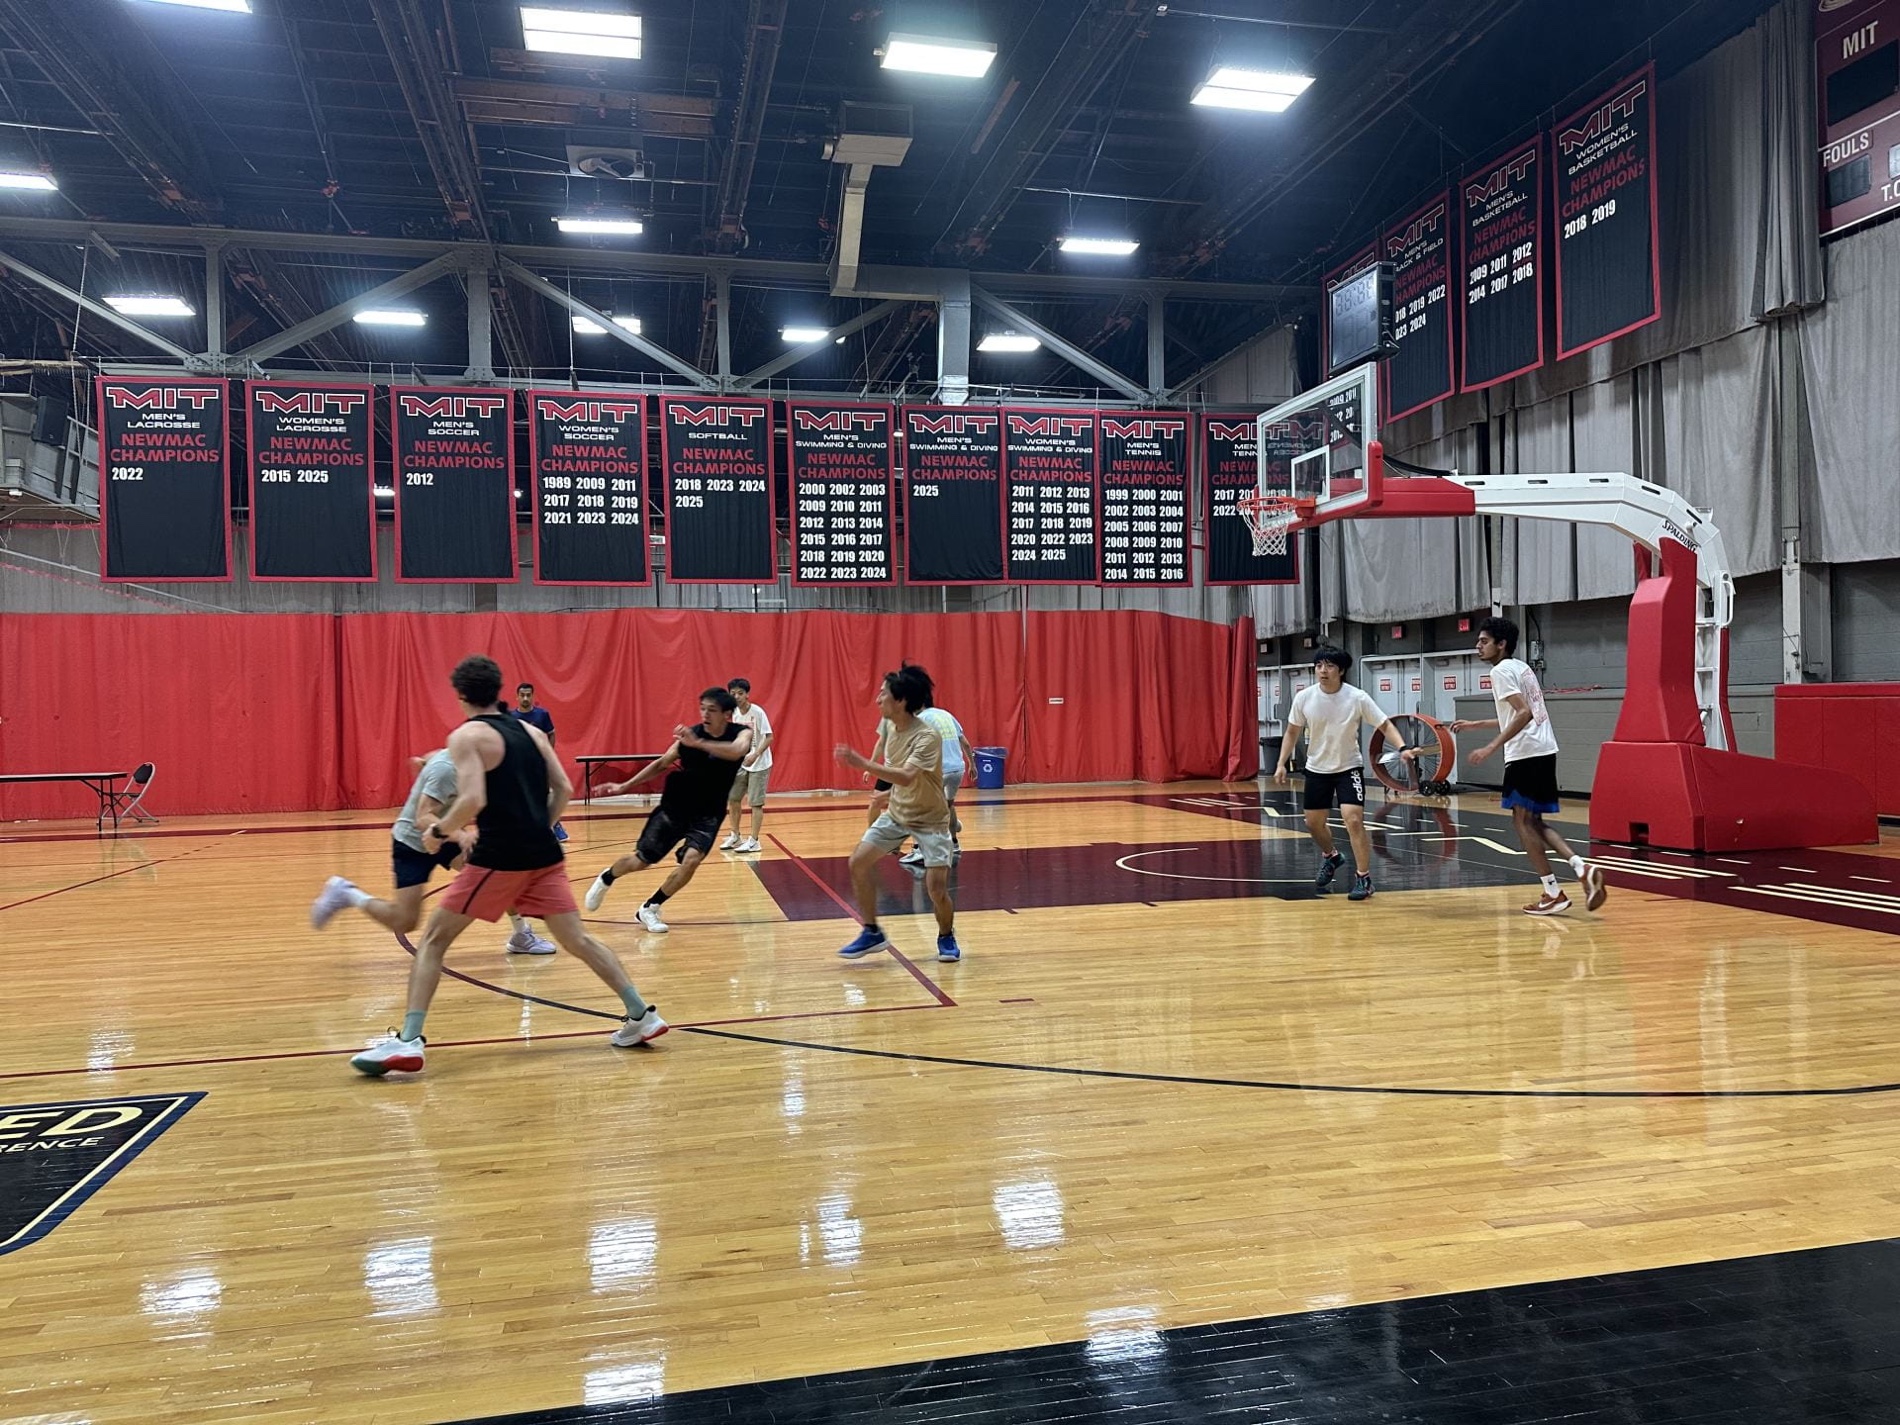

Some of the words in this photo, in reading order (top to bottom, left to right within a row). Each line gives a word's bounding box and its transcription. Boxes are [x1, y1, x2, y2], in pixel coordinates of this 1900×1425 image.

[1842, 21, 1878, 59] MIT
[1559, 80, 1646, 156] MIT
[1576, 122, 1629, 160] WOMEN'S
[1568, 130, 1638, 175] BASKETBALL
[1823, 133, 1869, 167] FOULS
[1570, 145, 1636, 194] NEWMAC
[1466, 149, 1536, 208] MIT
[1562, 158, 1645, 217] CHAMPIONS
[1486, 190, 1514, 211] MEN'S
[1473, 194, 1528, 227] BASKETBALL
[1474, 207, 1526, 244] NEWMAC
[1564, 214, 1587, 239] 2018
[1592, 199, 1616, 224] 2019
[1387, 203, 1444, 258] MIT
[1423, 238, 1444, 256] FIELD
[1469, 220, 1536, 265] CHAMPIONS
[1404, 240, 1428, 259] MEN'S
[1490, 254, 1506, 274] 2011
[1512, 242, 1532, 264] 2012
[1490, 274, 1508, 294] 2017
[1513, 262, 1533, 285] 2018
[1409, 296, 1425, 316] 2019
[1428, 284, 1446, 305] 2022
[1410, 313, 1426, 333] 2024
[106, 387, 219, 410] MIT
[255, 390, 365, 415] MIT
[400, 396, 504, 418] MIT
[538, 400, 638, 423] MIT
[279, 417, 345, 425] WOMEN'S
[669, 405, 764, 427] MIT
[795, 410, 885, 431] MIT
[909, 414, 998, 434] MIT
[1008, 416, 1092, 436] MIT
[1101, 420, 1184, 439] MIT
[122, 434, 206, 446] NEWMAC
[270, 436, 353, 451] NEWMAC
[414, 441, 493, 454] NEWMAC
[552, 445, 628, 458] NEWMAC
[683, 448, 754, 460] NEWMAC
[111, 449, 219, 462] CHAMPIONS
[258, 451, 365, 466] CHAMPIONS
[404, 455, 505, 469] CHAMPIONS
[808, 453, 876, 465] NEWMAC
[921, 455, 988, 467] NEWMAC
[541, 460, 638, 474] CHAMPIONS
[673, 462, 765, 475] CHAMPIONS
[1019, 457, 1082, 469] NEWMAC
[1113, 460, 1174, 472] NEWMAC
[112, 467, 143, 480] 2022
[261, 469, 291, 482] 2015
[297, 470, 329, 483] 2025
[406, 473, 434, 485] 2012
[799, 468, 886, 479] CHAMPIONS
[912, 468, 997, 480] CHAMPIONS
[1010, 470, 1092, 482] CHAMPIONS
[1104, 474, 1183, 485] CHAMPIONS
[543, 477, 571, 489] 1989
[576, 477, 605, 489] 2009
[612, 479, 636, 491] 2011
[675, 479, 701, 491] 2018
[707, 479, 734, 491] 2023
[739, 480, 765, 492] 2024
[799, 483, 825, 494] 2000
[830, 484, 855, 495] 2002
[860, 484, 885, 496] 2003
[913, 485, 938, 496] 2025
[1012, 486, 1034, 497] 2011
[1040, 487, 1062, 498] 2012
[1066, 487, 1090, 498] 2013
[1105, 489, 1128, 500] 1999
[1132, 490, 1156, 500] 2000
[1160, 490, 1183, 501] 2001
[1214, 489, 1235, 500] 2017
[544, 495, 570, 506] 2017
[577, 496, 604, 507] 2018
[612, 496, 638, 508] 2019
[676, 496, 703, 507] 2025
[799, 500, 826, 511] 2009
[830, 501, 854, 512] 2010
[860, 501, 882, 512] 2011
[1012, 502, 1035, 513] 2014
[1040, 503, 1063, 514] 2015
[1066, 503, 1089, 514] 2016
[1105, 505, 1129, 516] 2002
[1132, 506, 1156, 517] 2003
[1160, 506, 1183, 517] 2004
[1213, 505, 1236, 516] 2022
[544, 512, 571, 524] 2021
[577, 513, 606, 524] 2023
[611, 513, 639, 524] 2024
[800, 517, 824, 528] 2012
[831, 517, 855, 529] 2013
[860, 517, 883, 529] 2014
[1012, 517, 1034, 529] 2017
[1041, 518, 1064, 529] 2018
[1069, 517, 1092, 528] 2019
[1104, 521, 1129, 532] 2005
[1132, 521, 1156, 532] 2006
[1160, 522, 1183, 532] 2007
[800, 534, 825, 545] 2015
[831, 534, 856, 545] 2016
[860, 534, 882, 545] 2017
[1011, 534, 1035, 545] 2020
[1041, 534, 1065, 545] 2022
[1069, 533, 1093, 544] 2023
[1105, 537, 1129, 548] 2008
[1132, 537, 1156, 548] 2009
[1161, 537, 1183, 548] 2010
[1662, 520, 1698, 552] SPALDING
[800, 551, 825, 562] 2018
[831, 551, 855, 562] 2019
[859, 550, 884, 562] 2020
[1012, 550, 1036, 561] 2024
[1041, 549, 1066, 560] 2025
[1105, 553, 1126, 564] 2011
[1133, 553, 1155, 564] 2012
[1161, 553, 1183, 564] 2013
[800, 567, 826, 579] 2022
[831, 567, 857, 579] 2023
[861, 567, 886, 579] 2024
[1105, 569, 1127, 580] 2014
[1134, 568, 1156, 579] 2015
[1161, 569, 1183, 580] 2016
